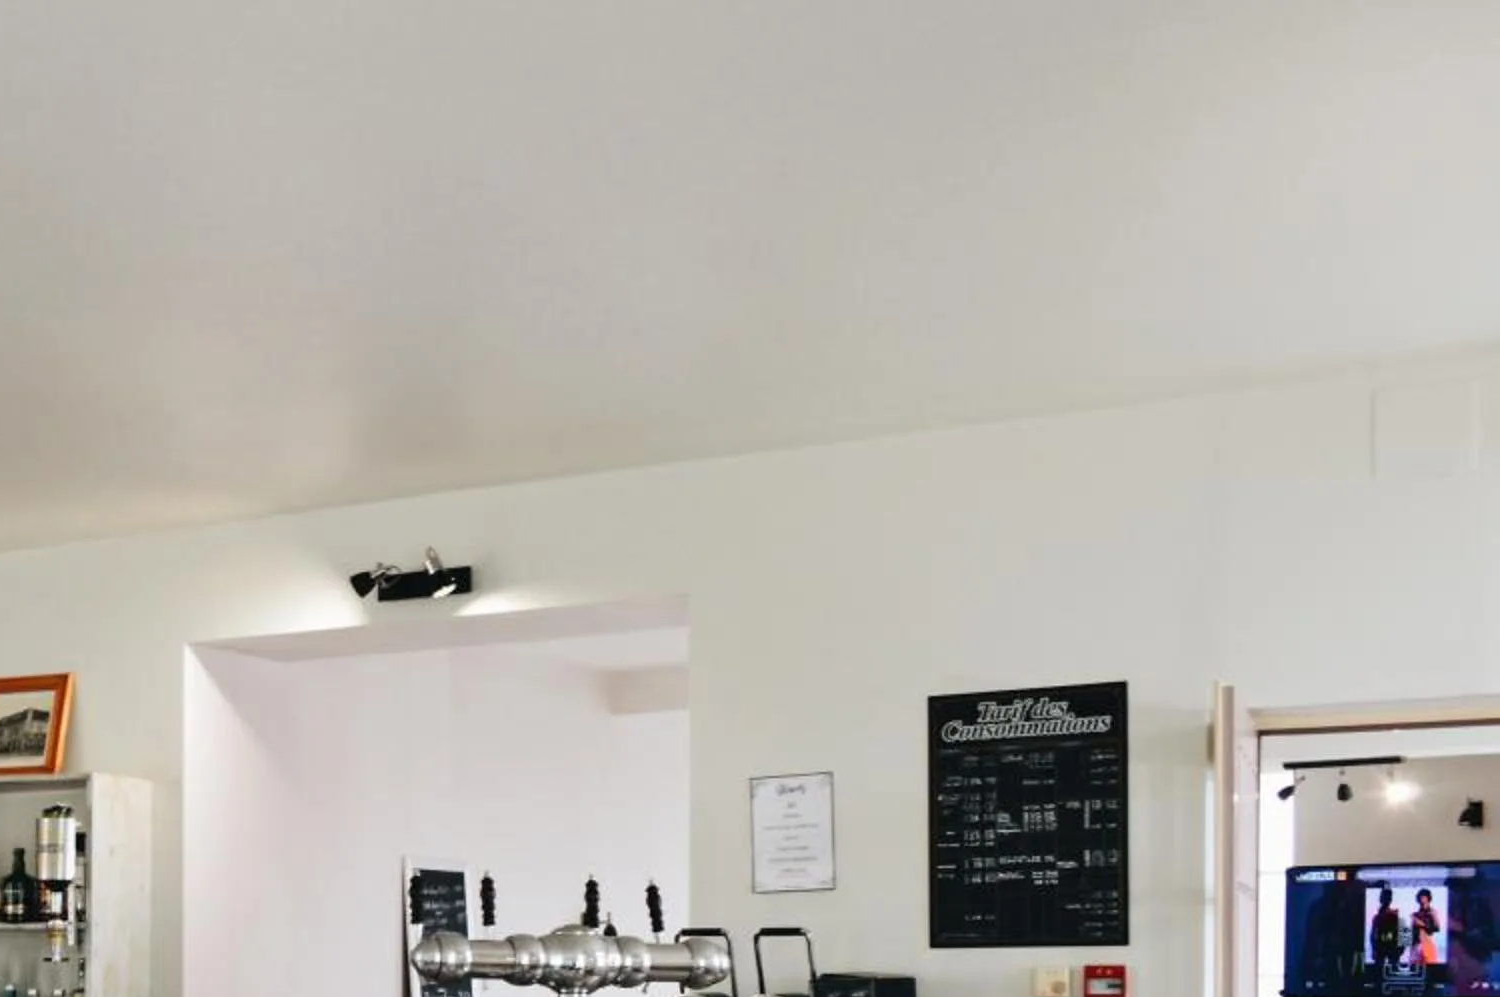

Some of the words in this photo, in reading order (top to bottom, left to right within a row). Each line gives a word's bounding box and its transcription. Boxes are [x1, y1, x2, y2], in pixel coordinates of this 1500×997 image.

[976, 698, 1033, 723] Tarif
[1031, 697, 1069, 719] des
[942, 713, 1112, 741] Consommations
